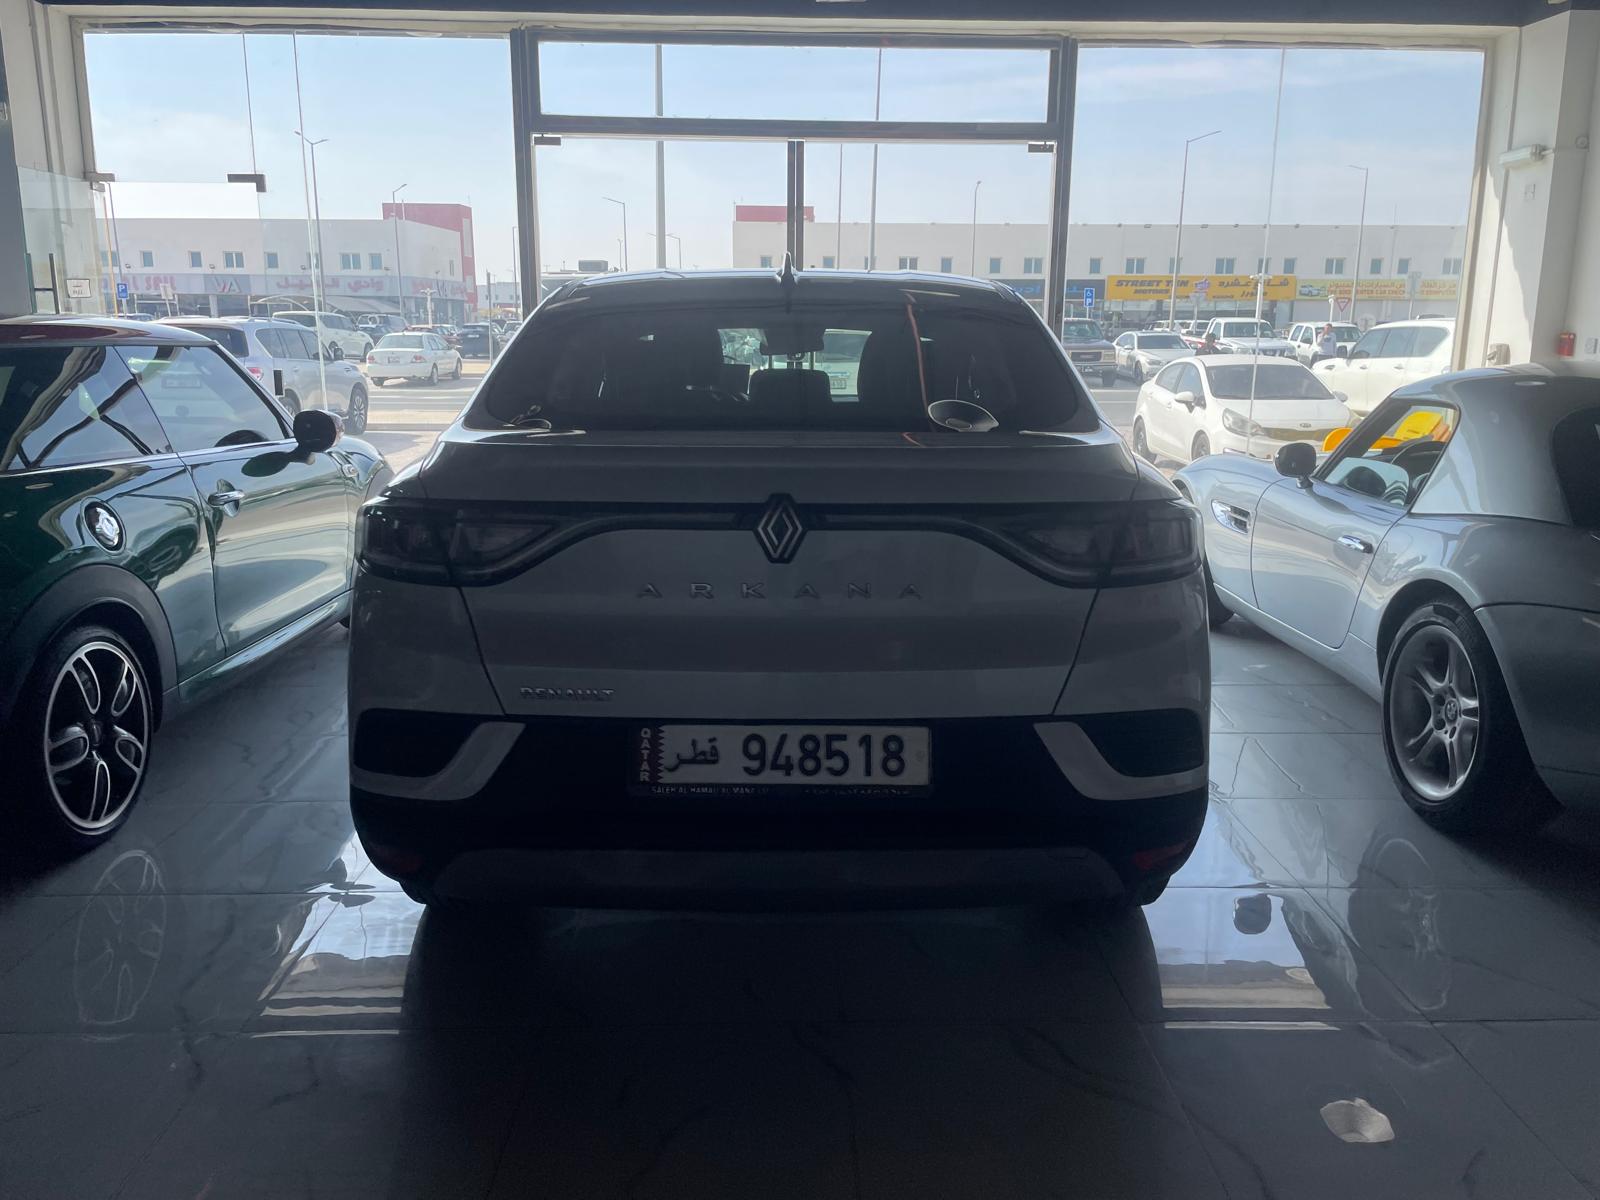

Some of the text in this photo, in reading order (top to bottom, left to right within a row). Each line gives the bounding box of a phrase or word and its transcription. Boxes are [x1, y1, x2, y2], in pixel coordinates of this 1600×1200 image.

[118, 284, 125, 292] P
[1115, 279, 1162, 287] STREET
[1086, 298, 1092, 306] P
[635, 582, 923, 600] ARKANA
[519, 687, 616, 701] RENAULT
[640, 727, 652, 782] QATAR
[663, 736, 719, 772] قطر
[742, 732, 906, 777] 948518
